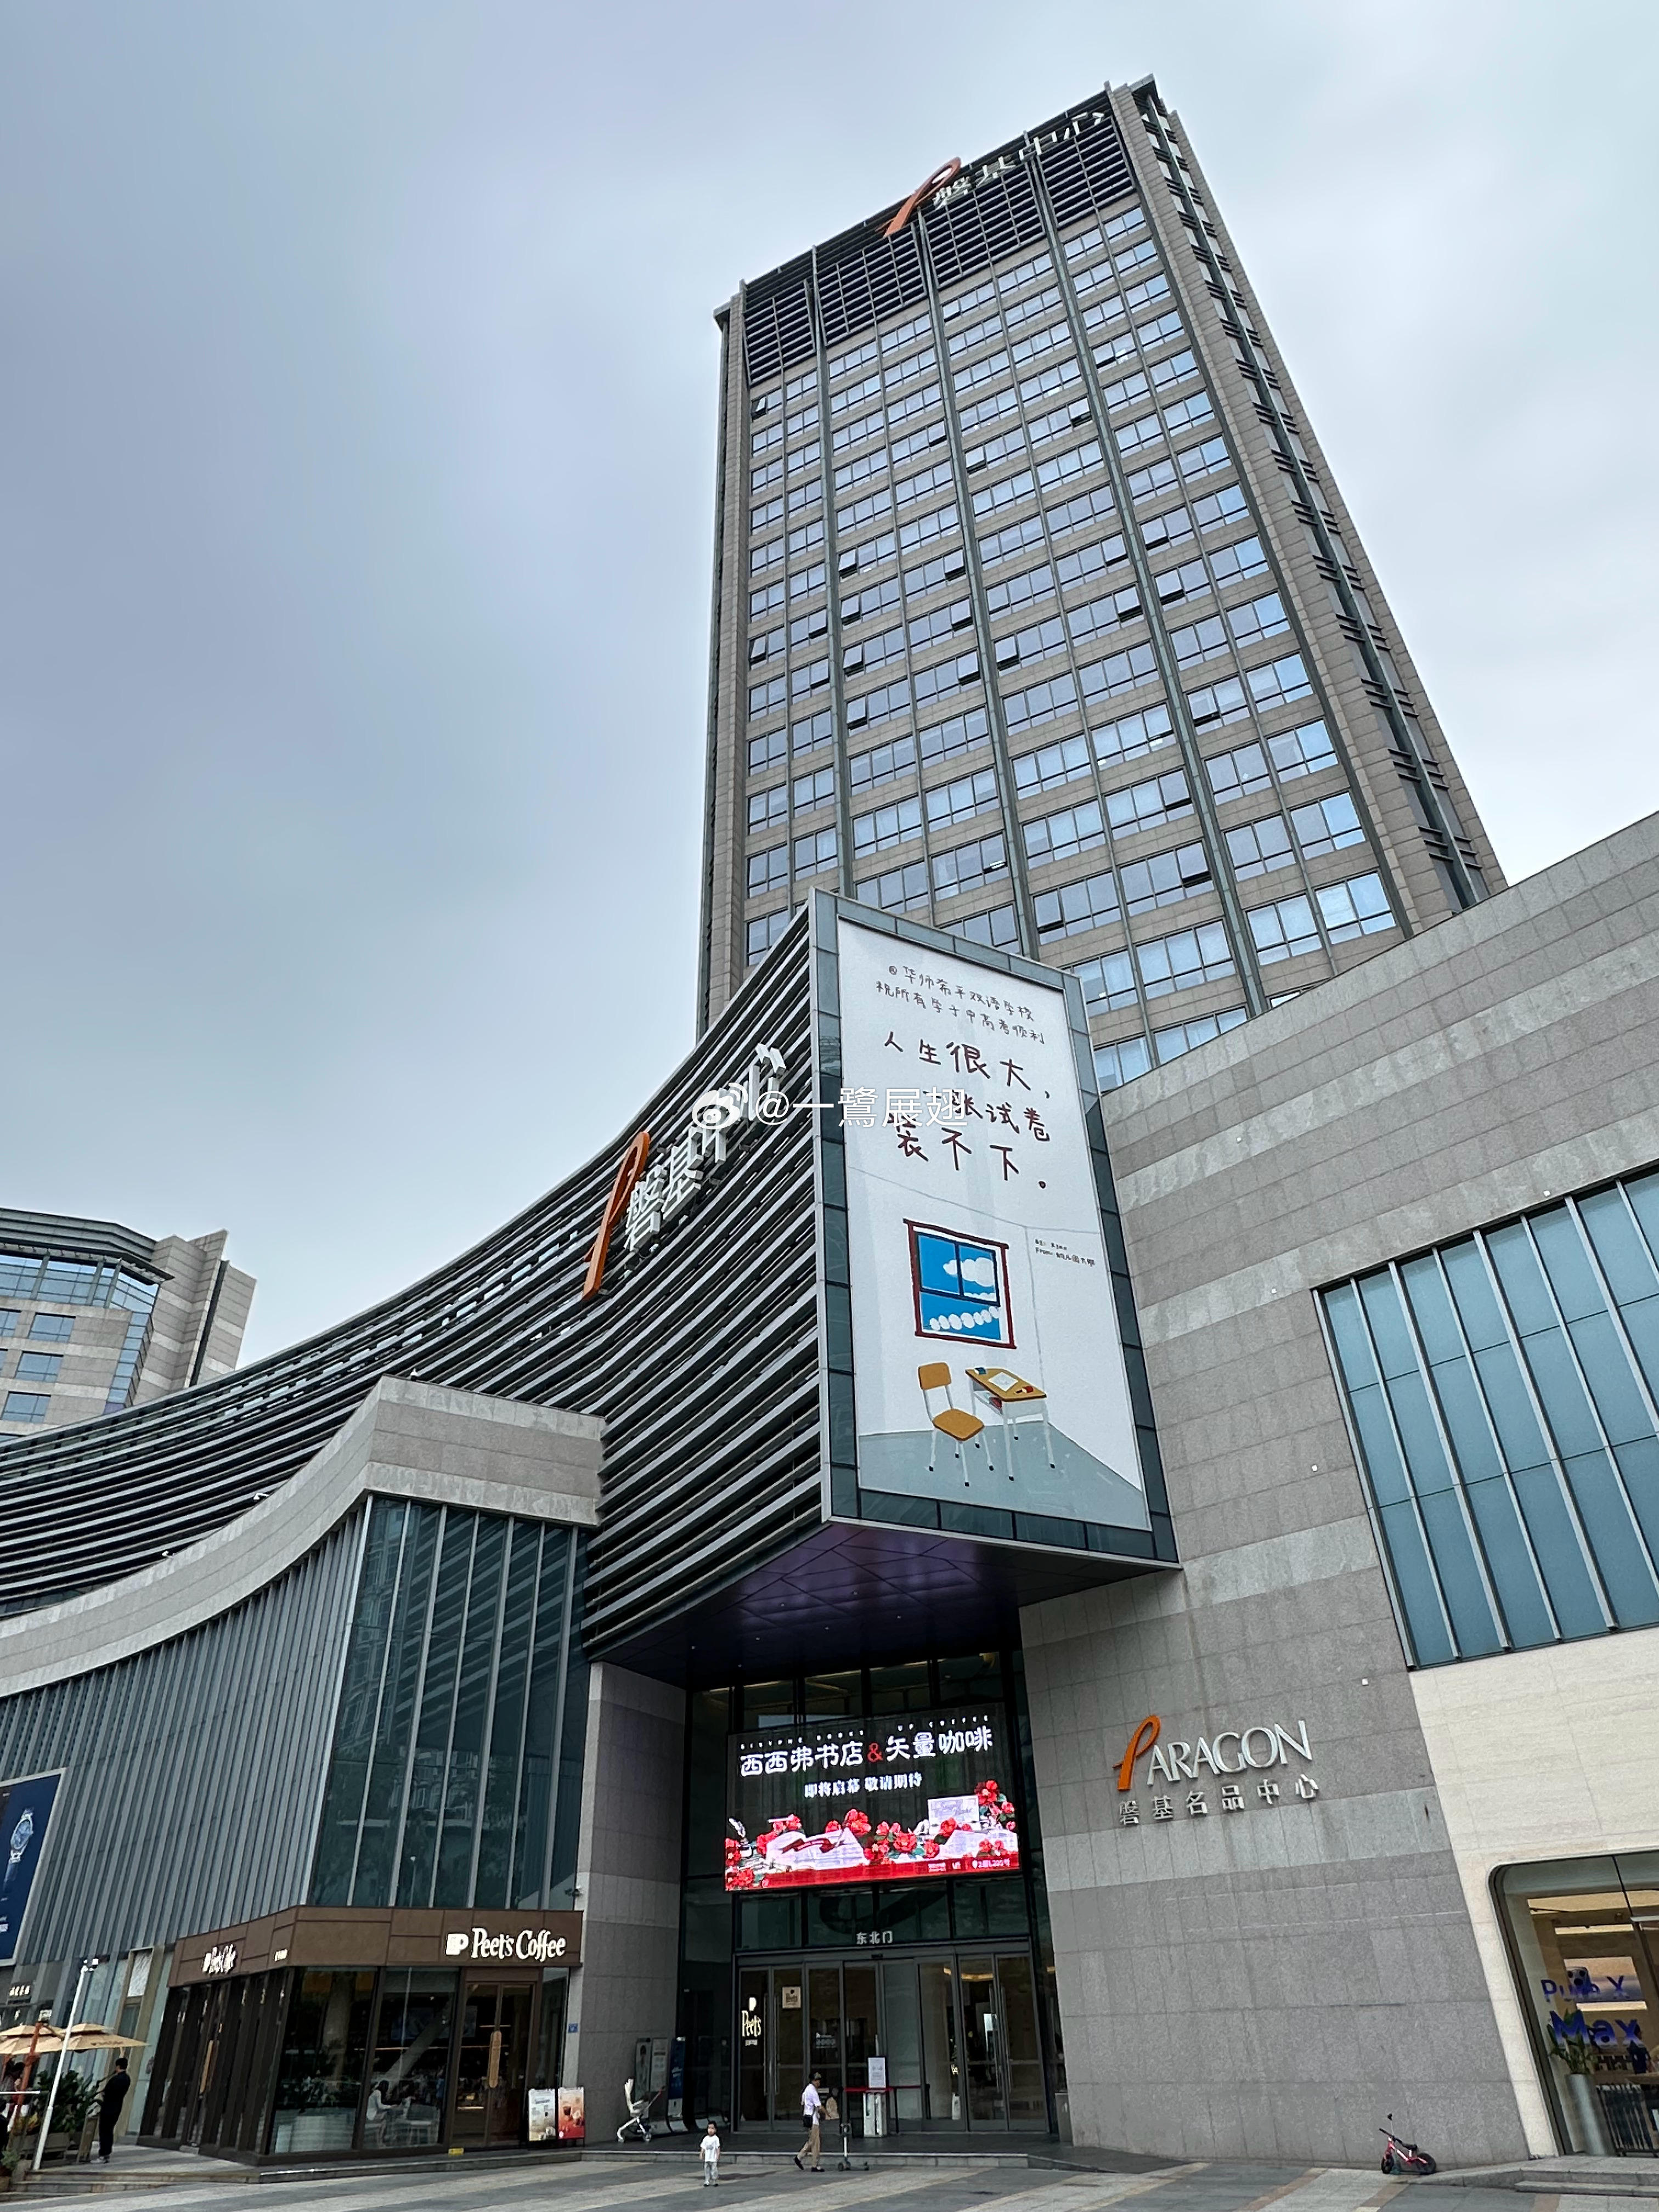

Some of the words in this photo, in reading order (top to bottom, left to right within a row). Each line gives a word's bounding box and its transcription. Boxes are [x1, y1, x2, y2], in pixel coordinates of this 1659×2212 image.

[1112, 1714, 1313, 1791] PARAGON
[1119, 1774, 1319, 1826] 磐基名品中心
[471, 1927, 515, 1960] Peet's
[516, 1929, 566, 1962] Coffee
[856, 1931, 893, 1945] 东北门
[1549, 2009, 1646, 2049] Max
